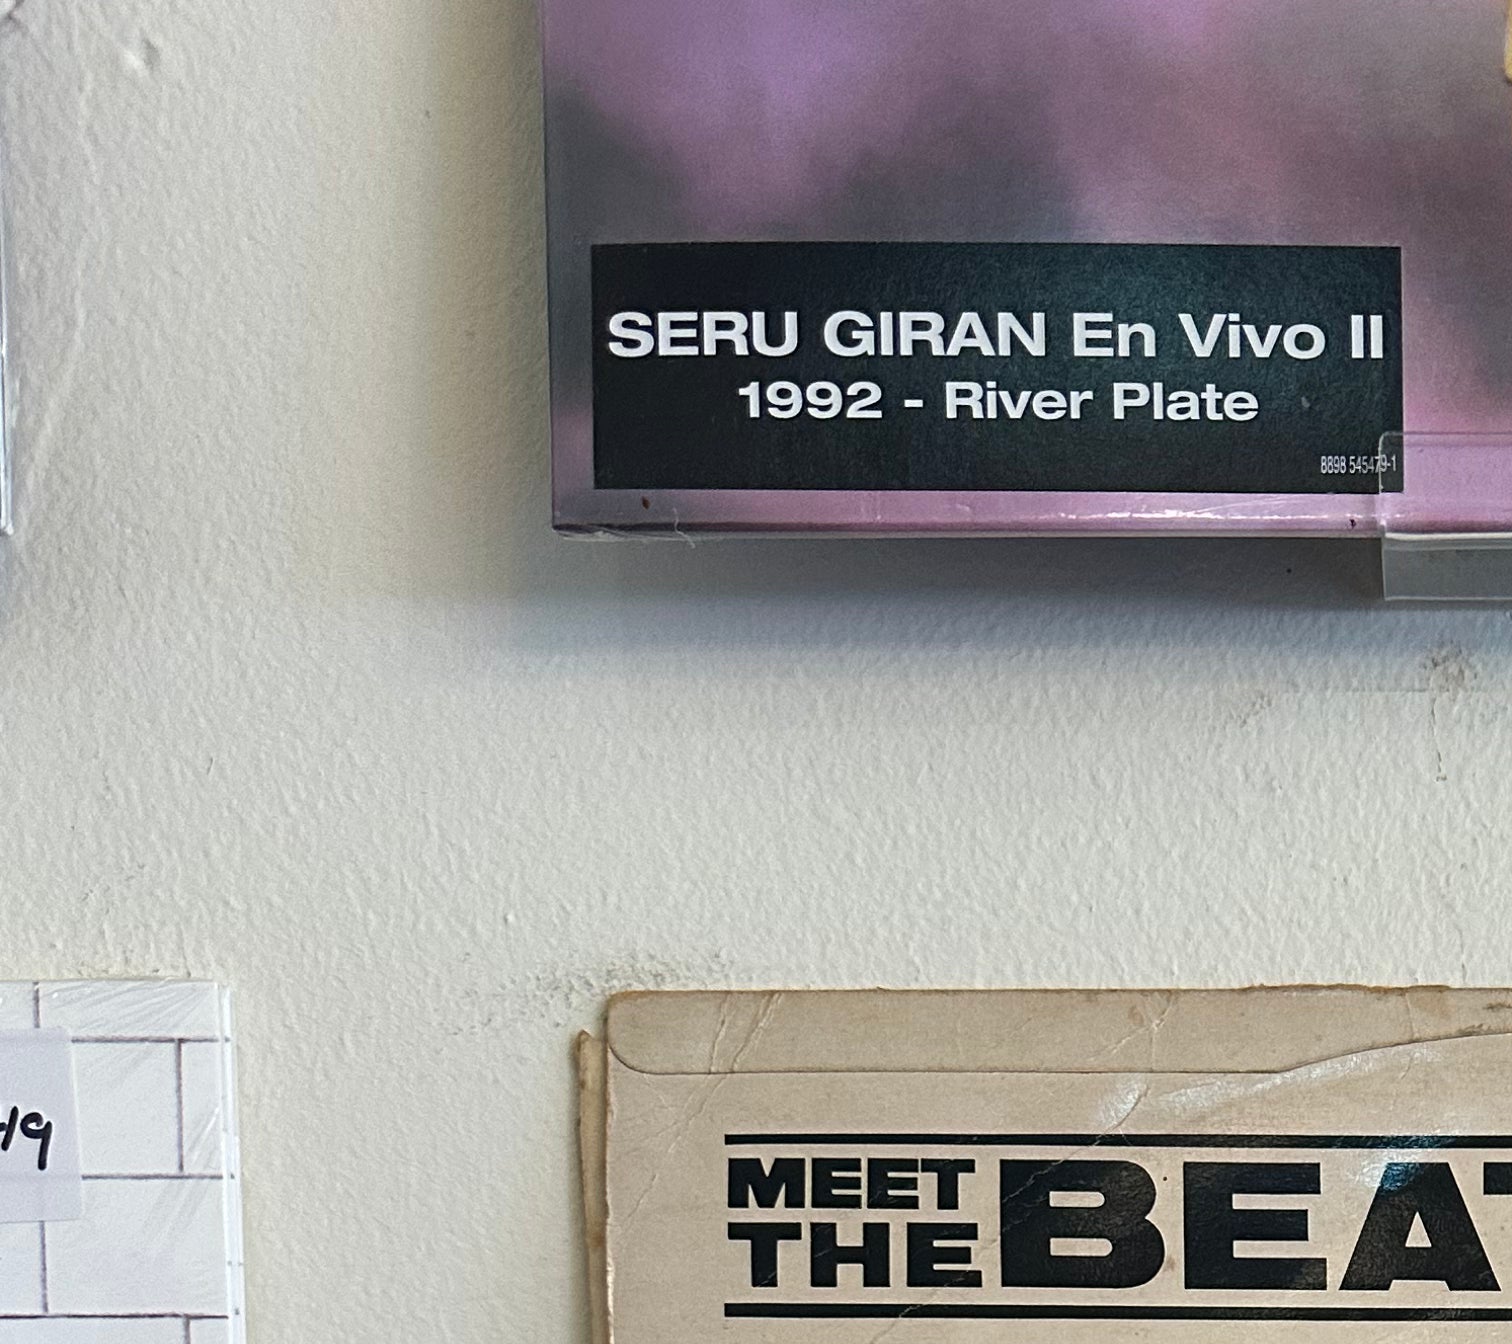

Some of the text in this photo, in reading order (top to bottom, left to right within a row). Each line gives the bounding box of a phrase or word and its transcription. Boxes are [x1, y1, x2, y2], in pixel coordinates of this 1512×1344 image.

[608, 311, 1385, 360] SERU GIRAN En Vivo II
[738, 381, 884, 421] 1992
[945, 380, 1094, 421] River
[1113, 381, 1259, 422] Plate
[1320, 455, 1347, 474] 8898
[727, 1157, 976, 1211] MEET
[726, 1221, 983, 1289] THE
